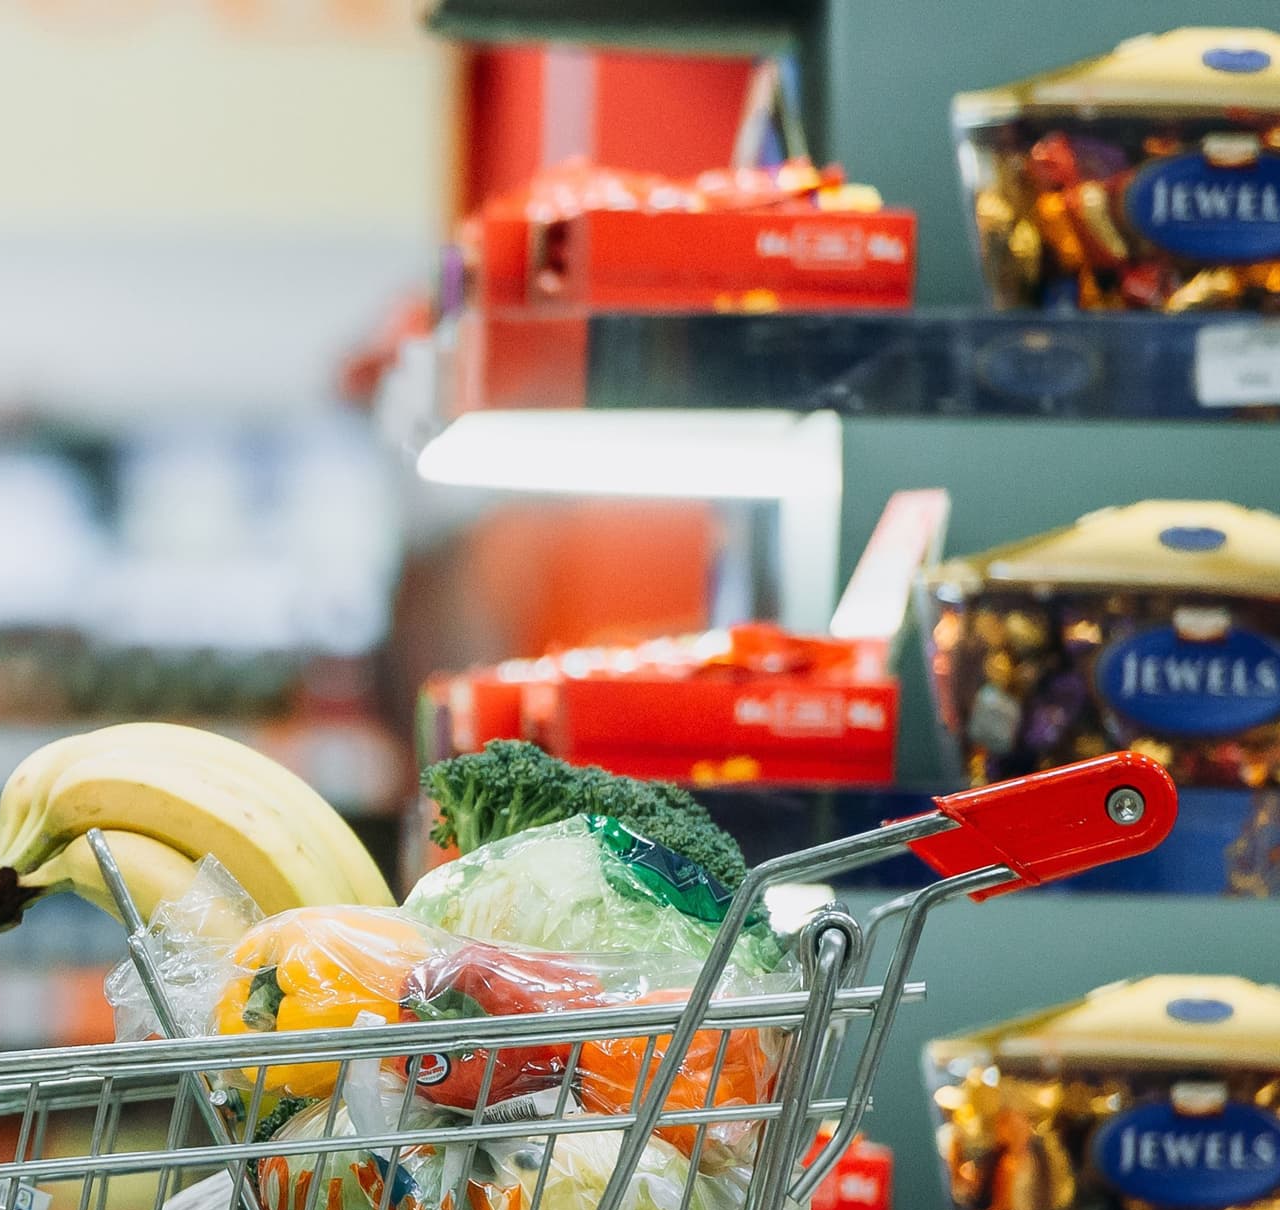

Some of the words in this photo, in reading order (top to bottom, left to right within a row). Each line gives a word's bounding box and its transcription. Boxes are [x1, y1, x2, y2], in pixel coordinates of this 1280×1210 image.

[1151, 179, 1280, 226] JEWEL
[1122, 654, 1278, 698] JEWELS
[1121, 1129, 1276, 1174] JEWELS
